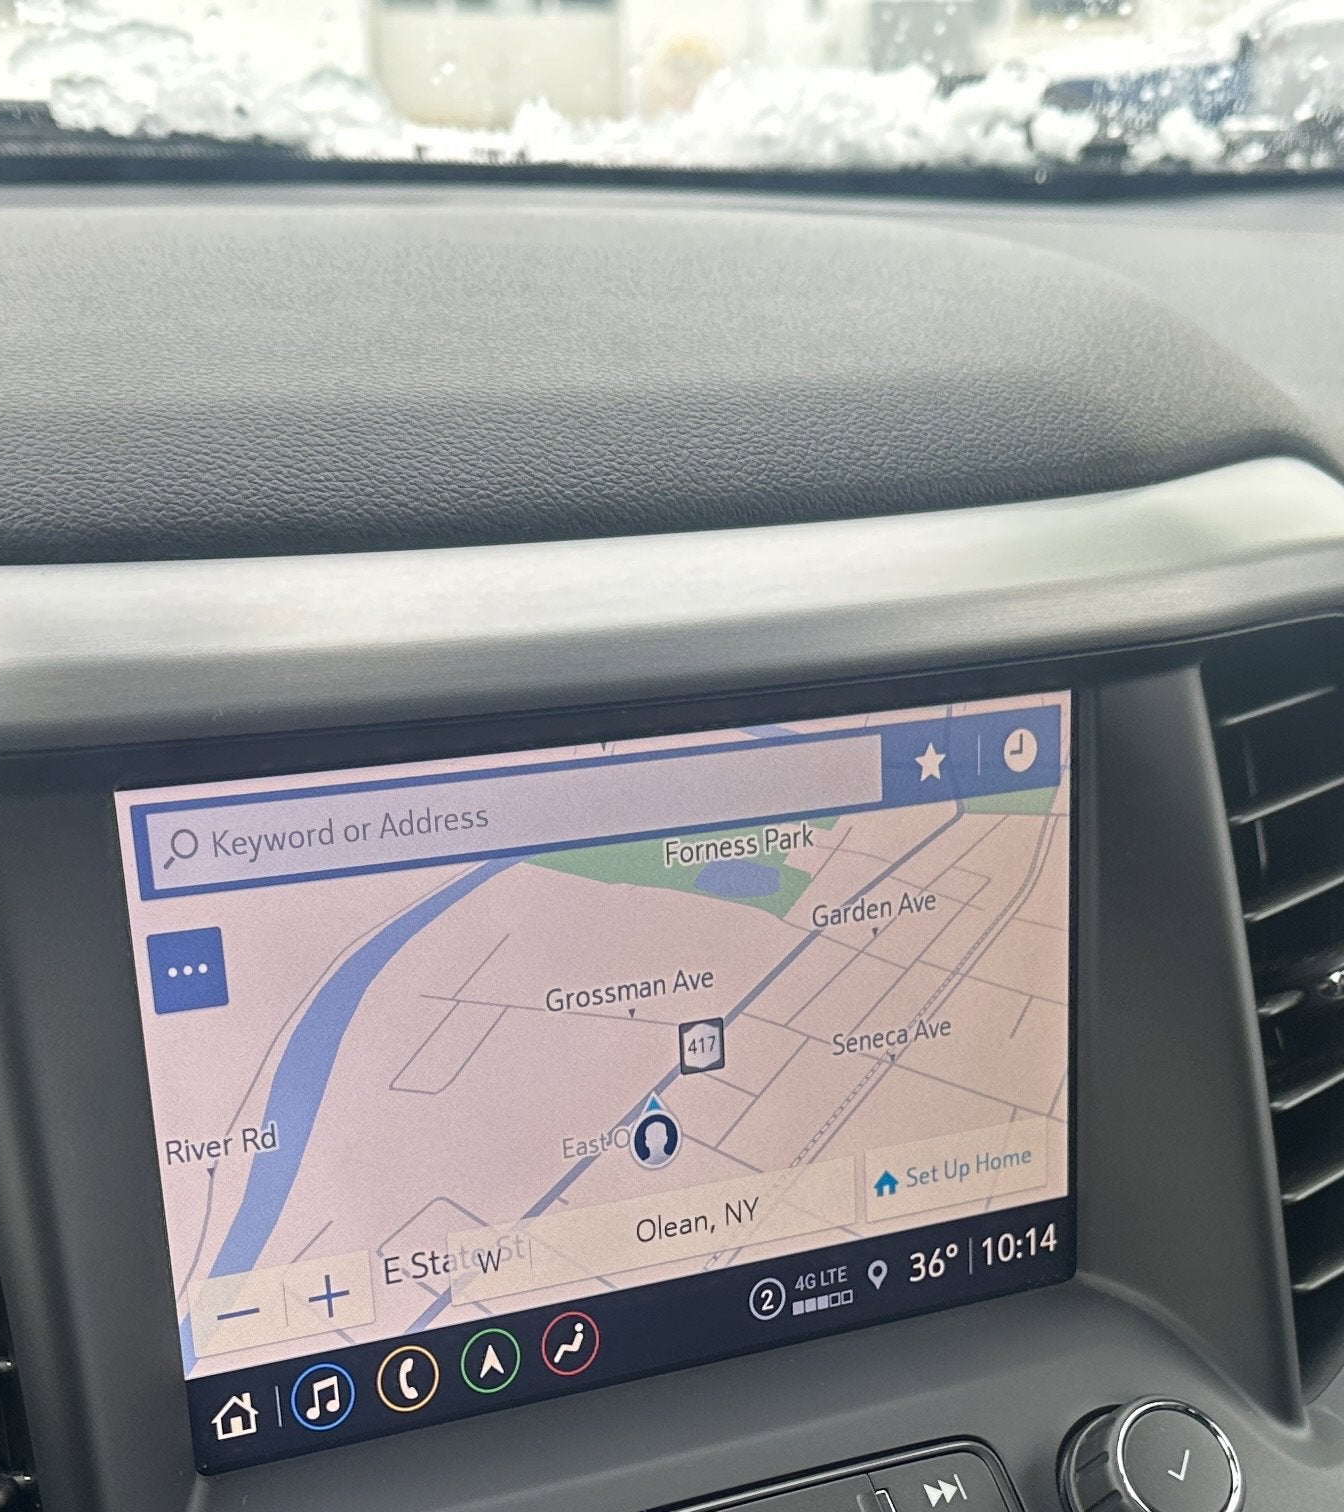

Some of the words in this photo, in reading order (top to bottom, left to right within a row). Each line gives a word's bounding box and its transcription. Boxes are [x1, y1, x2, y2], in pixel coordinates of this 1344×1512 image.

[211, 818, 335, 862] Keyword
[344, 822, 371, 843] or
[379, 806, 489, 840] Address
[664, 834, 758, 865] Forness
[765, 823, 814, 853] Park
[812, 896, 893, 928] Garden
[896, 892, 937, 914] Ave
[546, 976, 666, 1012] Grossman
[672, 967, 714, 993] Ave
[687, 1034, 716, 1055] 417
[831, 1025, 909, 1056] Seneca
[914, 1018, 952, 1043] Ave
[166, 1134, 233, 1166] River
[242, 1123, 277, 1153] Rd
[563, 1132, 609, 1159] East
[906, 1163, 939, 1189] Set
[944, 1160, 970, 1184] Up
[975, 1148, 1032, 1175] Home
[636, 1214, 718, 1243] Olean,
[724, 1197, 760, 1225] NY
[477, 1247, 501, 1274] W
[981, 1224, 1057, 1267] 10:14
[384, 1256, 403, 1284] E
[795, 1273, 816, 1292] 4G
[819, 1265, 848, 1285] LTE
[760, 1291, 774, 1311] 2
